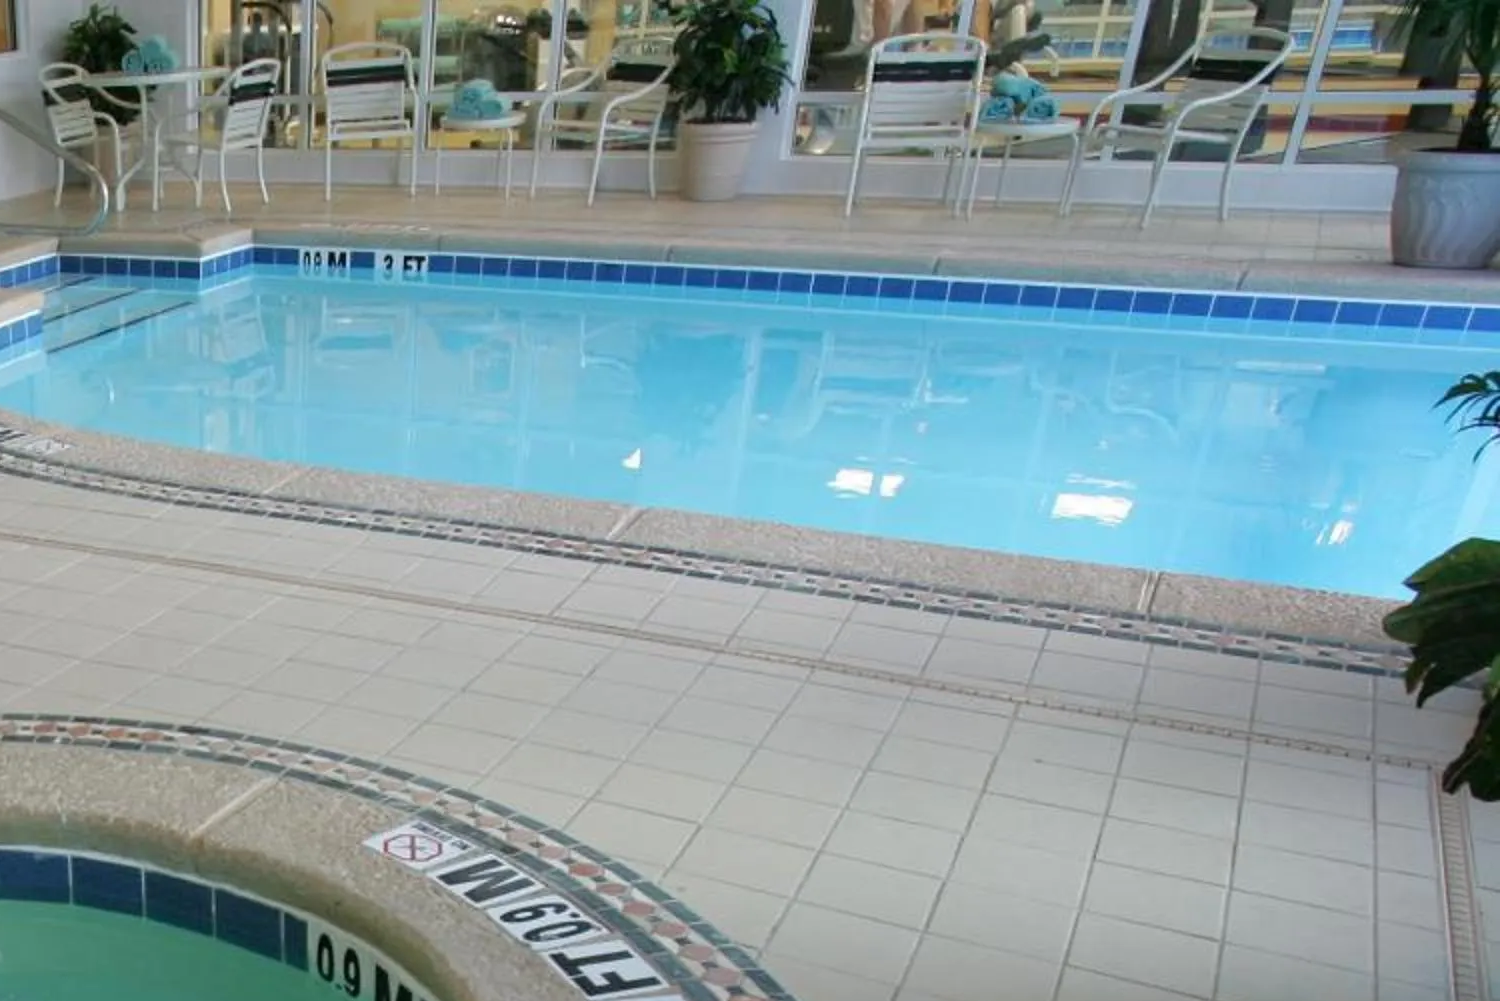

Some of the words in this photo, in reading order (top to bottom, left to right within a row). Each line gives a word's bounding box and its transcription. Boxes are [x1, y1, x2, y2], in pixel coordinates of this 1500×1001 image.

[436, 858, 536, 904] M
[500, 902, 595, 942] 0.9
[549, 950, 662, 997] FT
